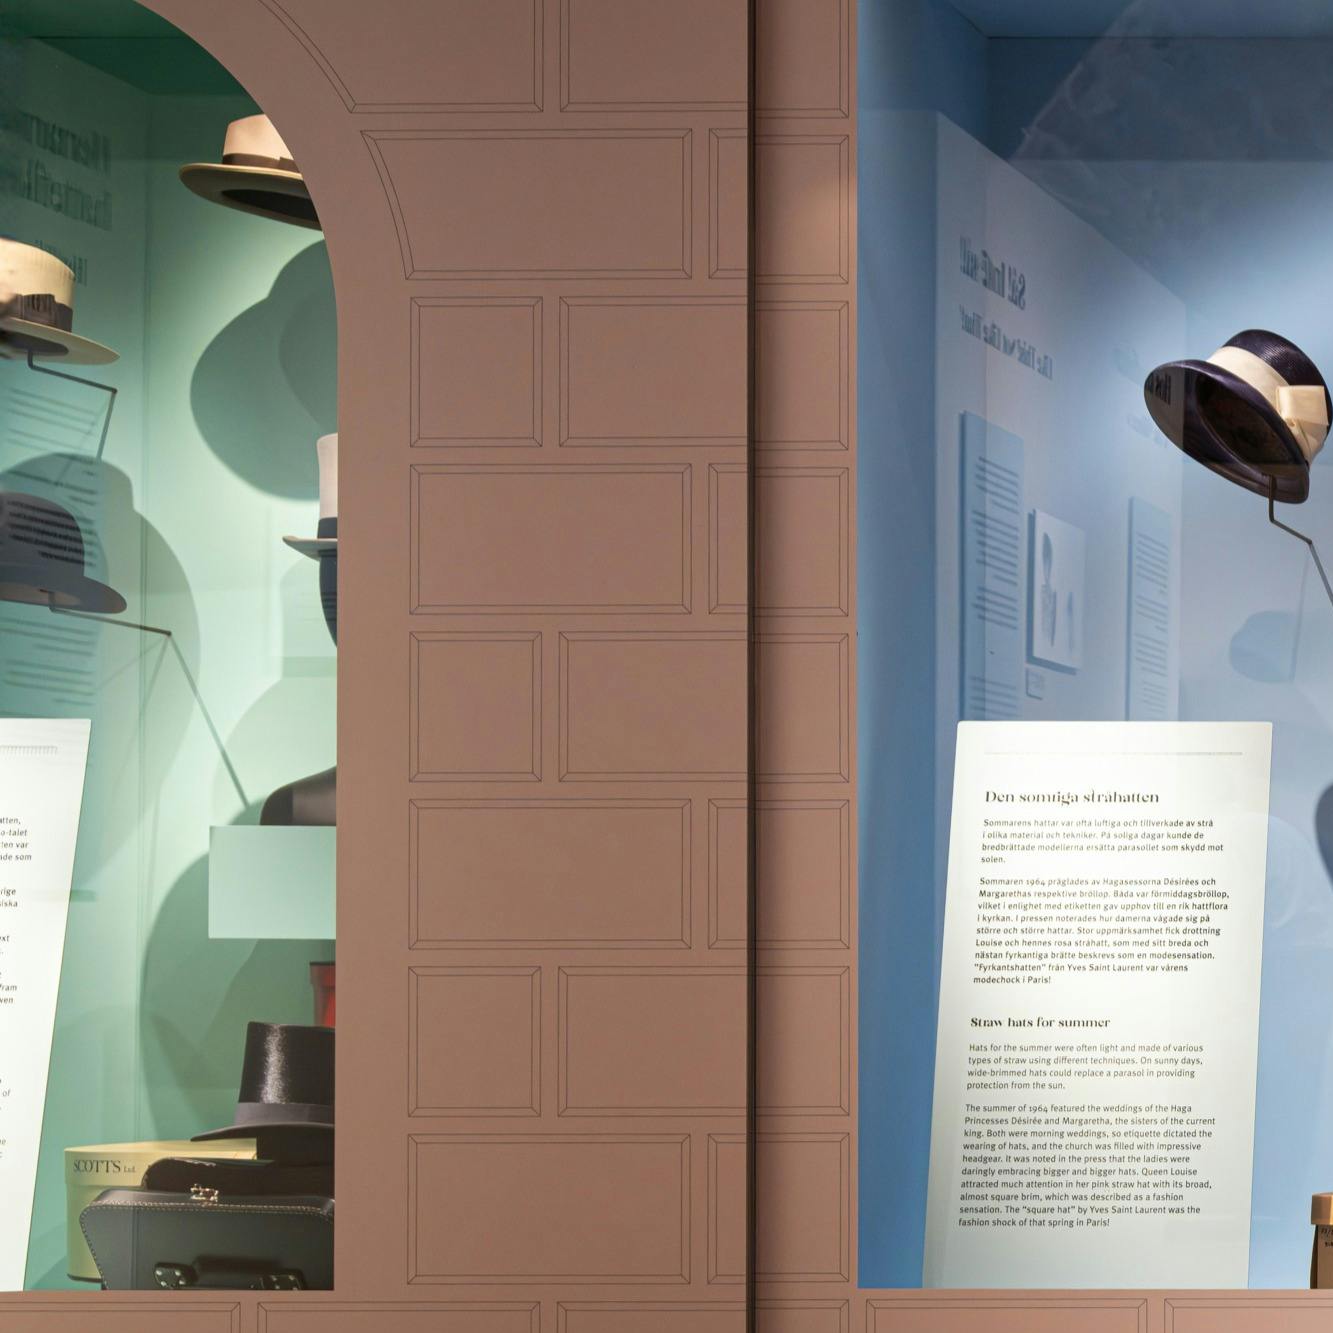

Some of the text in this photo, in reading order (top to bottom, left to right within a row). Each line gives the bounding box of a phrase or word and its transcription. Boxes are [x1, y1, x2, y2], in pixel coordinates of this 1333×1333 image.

[985, 790, 1159, 806] Den somriga stråhatten
[976, 925, 1221, 936] större och större hattar. Stor uppmärksamhet fick drottning
[975, 938, 1003, 947] Louise
[1004, 938, 1020, 947] och
[1022, 938, 1052, 947] hennes
[1074, 938, 1110, 947] stråhatt,
[1132, 938, 1150, 947] med
[1152, 938, 1166, 947] sitt
[1168, 938, 1192, 947] breda
[1193, 938, 1208, 947] och
[972, 975, 1020, 983] modechock
[1027, 975, 1051, 983] Paris!
[970, 1016, 1110, 1027] Straw hats for summer
[965, 1103, 981, 1112] The
[1028, 1103, 1048, 1114] 1964
[1050, 1103, 1086, 1112] featured
[1087, 1103, 1101, 1112] the
[1102, 1103, 1143, 1114] weddings
[1155, 1103, 1169, 1112] the
[1170, 1103, 1192, 1114] Haga
[964, 1115, 1009, 1125] Princesses
[1011, 1115, 1042, 1125] Désirée
[1044, 1115, 1060, 1125] and
[1062, 1115, 1113, 1127] Margaretha,
[1115, 1115, 1129, 1125] the
[1130, 1115, 1158, 1125] sisters
[1170, 1115, 1184, 1125] the
[1186, 1115, 1215, 1125] current
[958, 1216, 990, 1226] fashion
[992, 1216, 1017, 1226] shock
[1029, 1216, 1046, 1226] that
[1047, 1216, 1074, 1229] spring
[1086, 1216, 1110, 1226] Paris!
